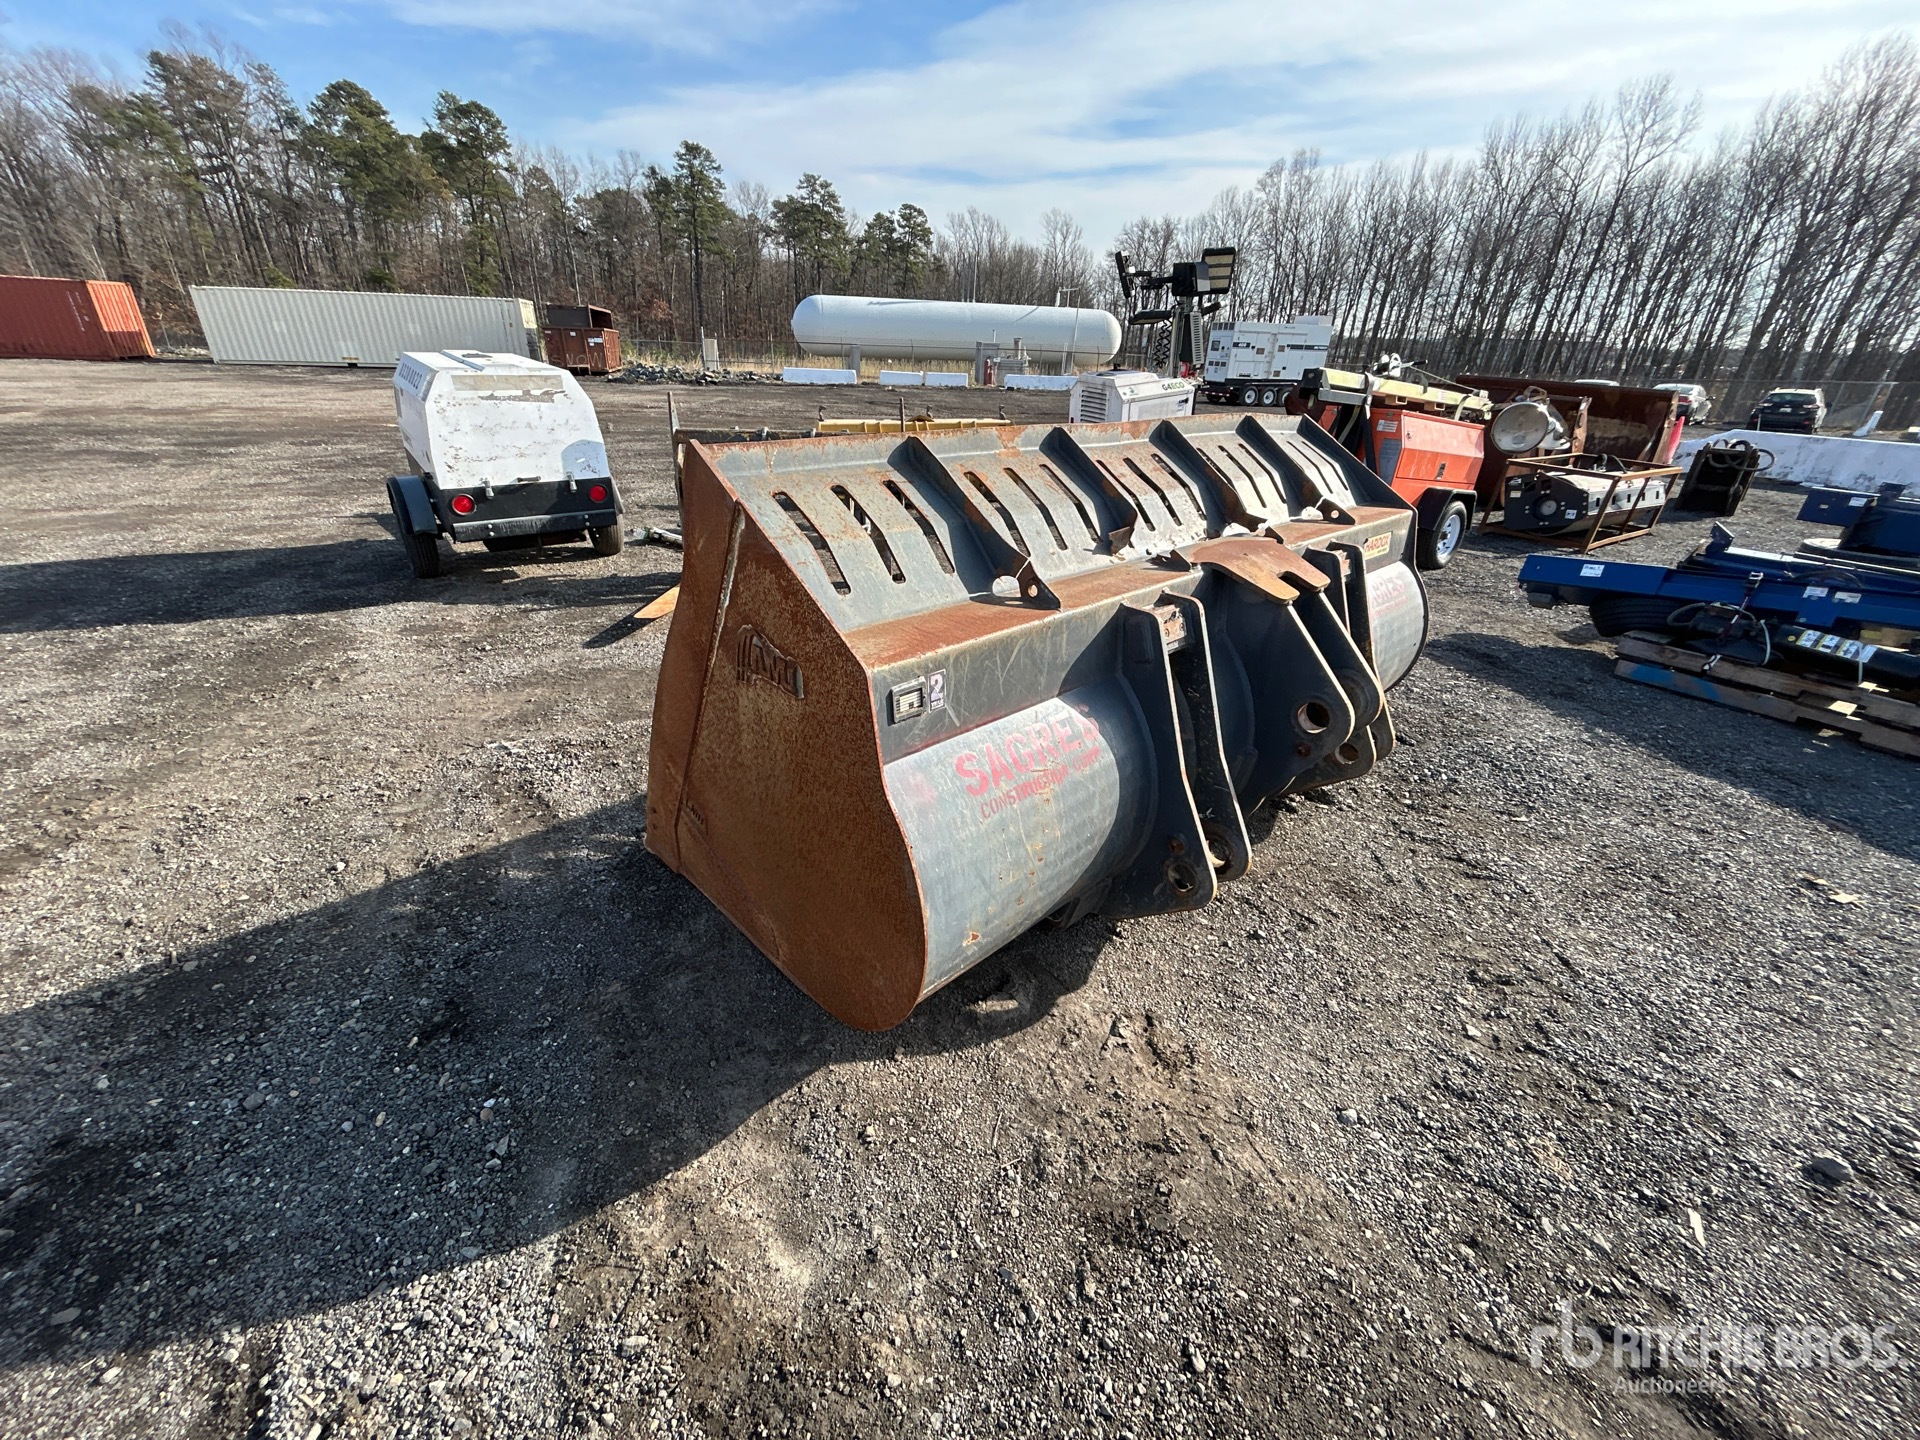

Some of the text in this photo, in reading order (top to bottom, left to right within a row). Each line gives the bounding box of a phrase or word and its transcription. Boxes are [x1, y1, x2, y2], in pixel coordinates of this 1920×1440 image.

[550, 351, 603, 368] SNOW
[930, 674, 943, 701] 2
[980, 763, 1069, 819] CONSTRUCTION
